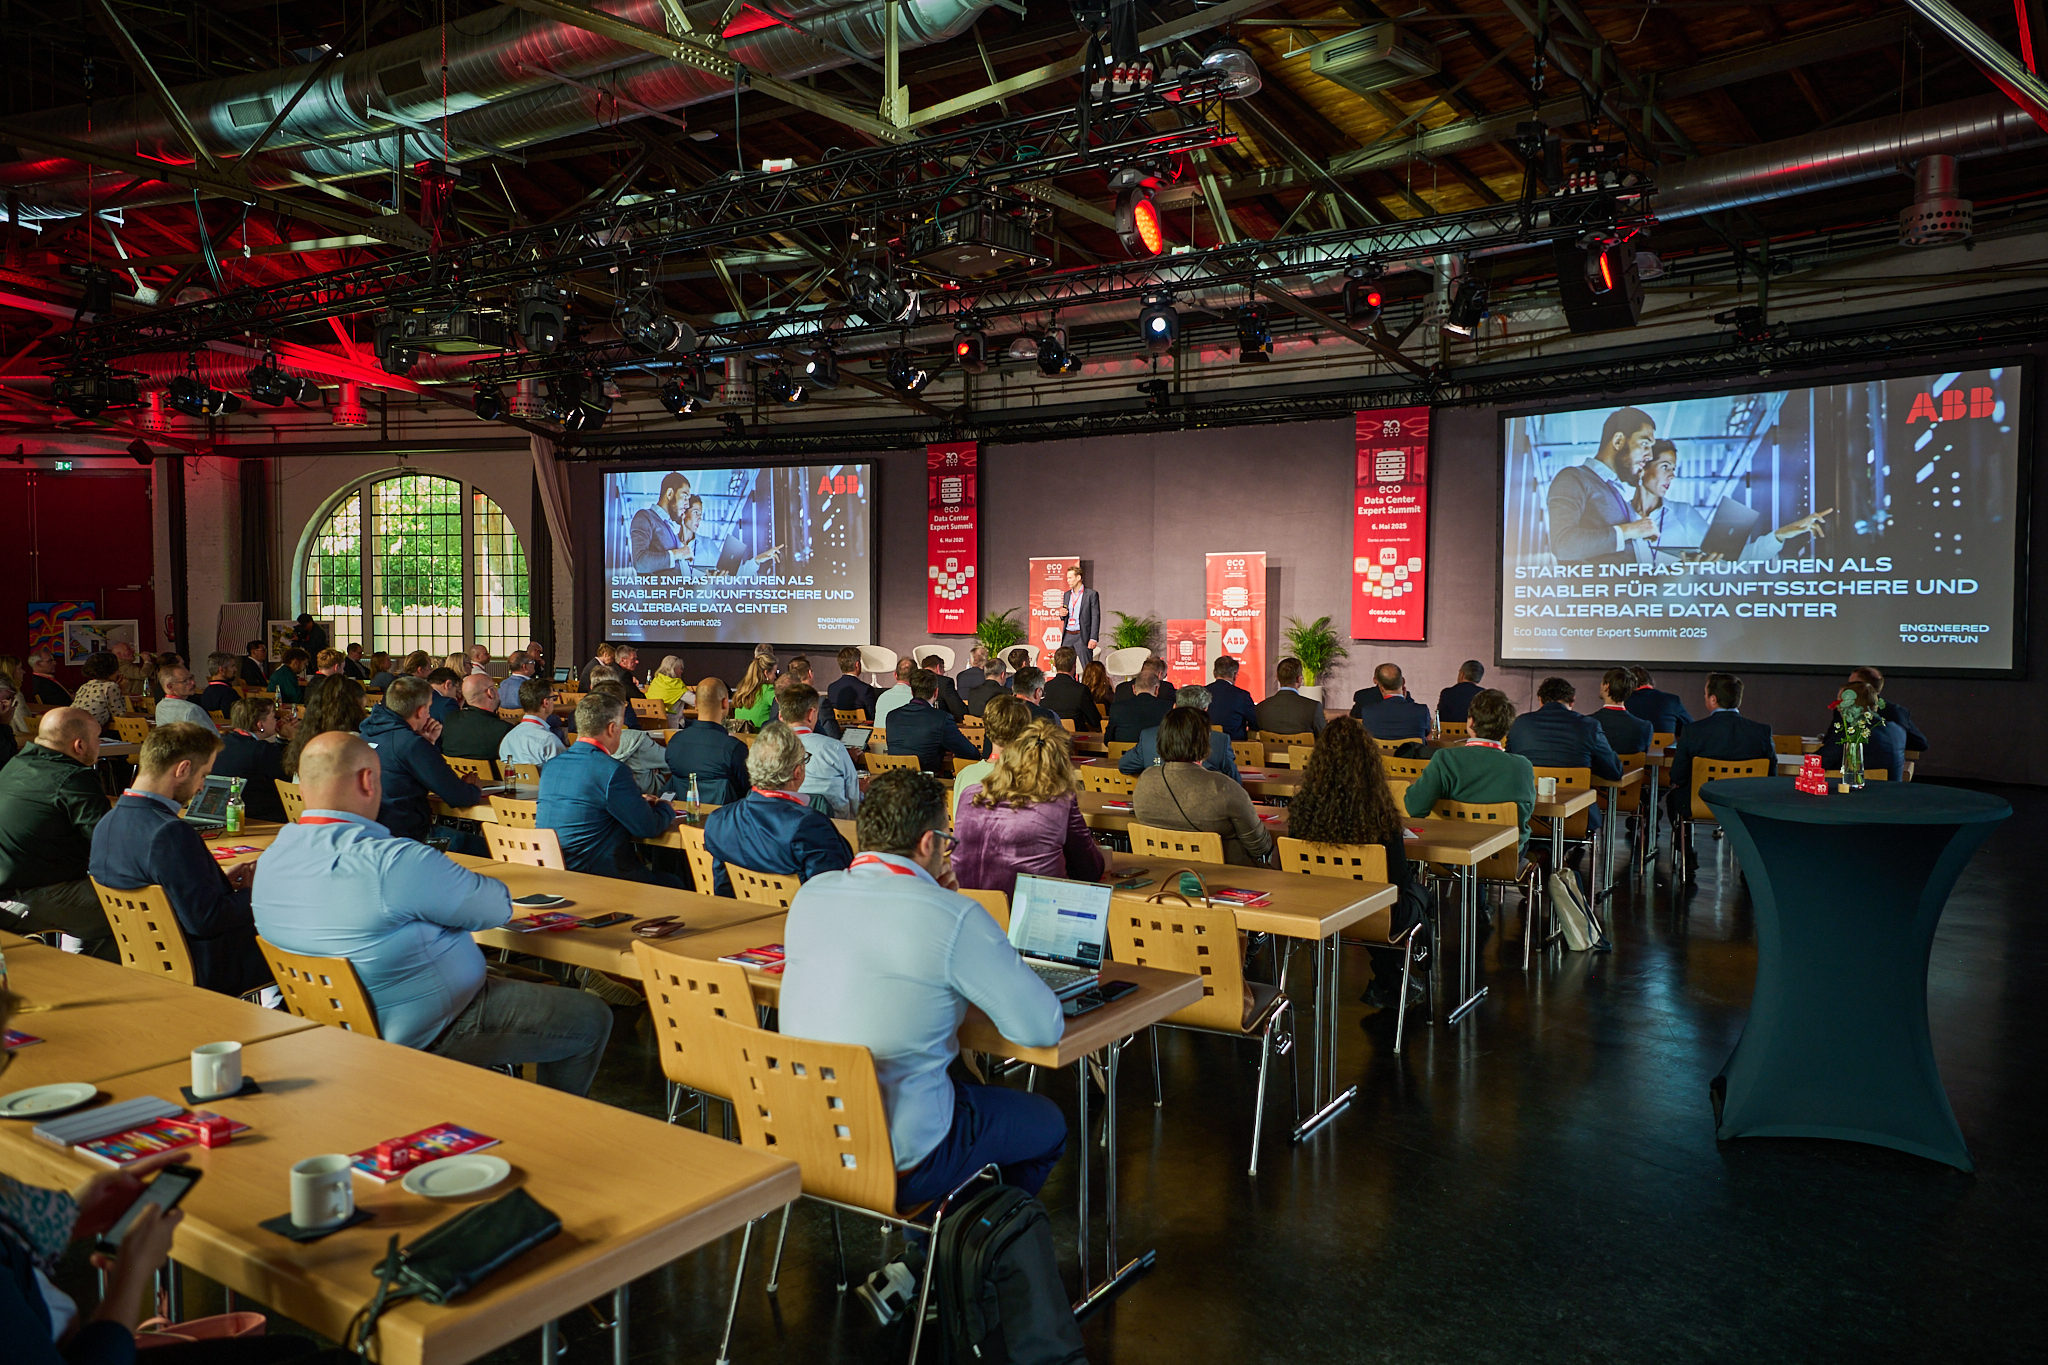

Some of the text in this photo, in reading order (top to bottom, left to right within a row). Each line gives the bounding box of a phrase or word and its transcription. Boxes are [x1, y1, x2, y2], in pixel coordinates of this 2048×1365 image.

[1906, 387, 1996, 424] ABB
[817, 474, 859, 495] ABB
[1379, 485, 1401, 494] eco
[1364, 496, 1384, 504] Data
[1358, 505, 1421, 516] Expert Summit
[1514, 556, 1892, 579] STARKE INFRASTRUKTUREN ALS
[611, 576, 814, 585] STARKE INFRASTRUKTUREN ALS
[612, 586, 855, 600] ENABLER FÜR ZUKUNFTSSICHERE UND
[1514, 579, 1979, 598] ENABLER FÜR ZUKUNFTSSICHERE UND
[611, 603, 788, 614] SKALIERBARE DATA CENTER
[1210, 608, 1260, 617] Data Center
[1514, 602, 1837, 618] SKALIERBARE DATA CENTER
[660, 619, 680, 627] Expert
[1900, 624, 1990, 632] ENGINEERED
[1513, 627, 1708, 639] Eco Data Center Expert Summit 2025
[1899, 634, 1978, 643] TO OUTRUN
